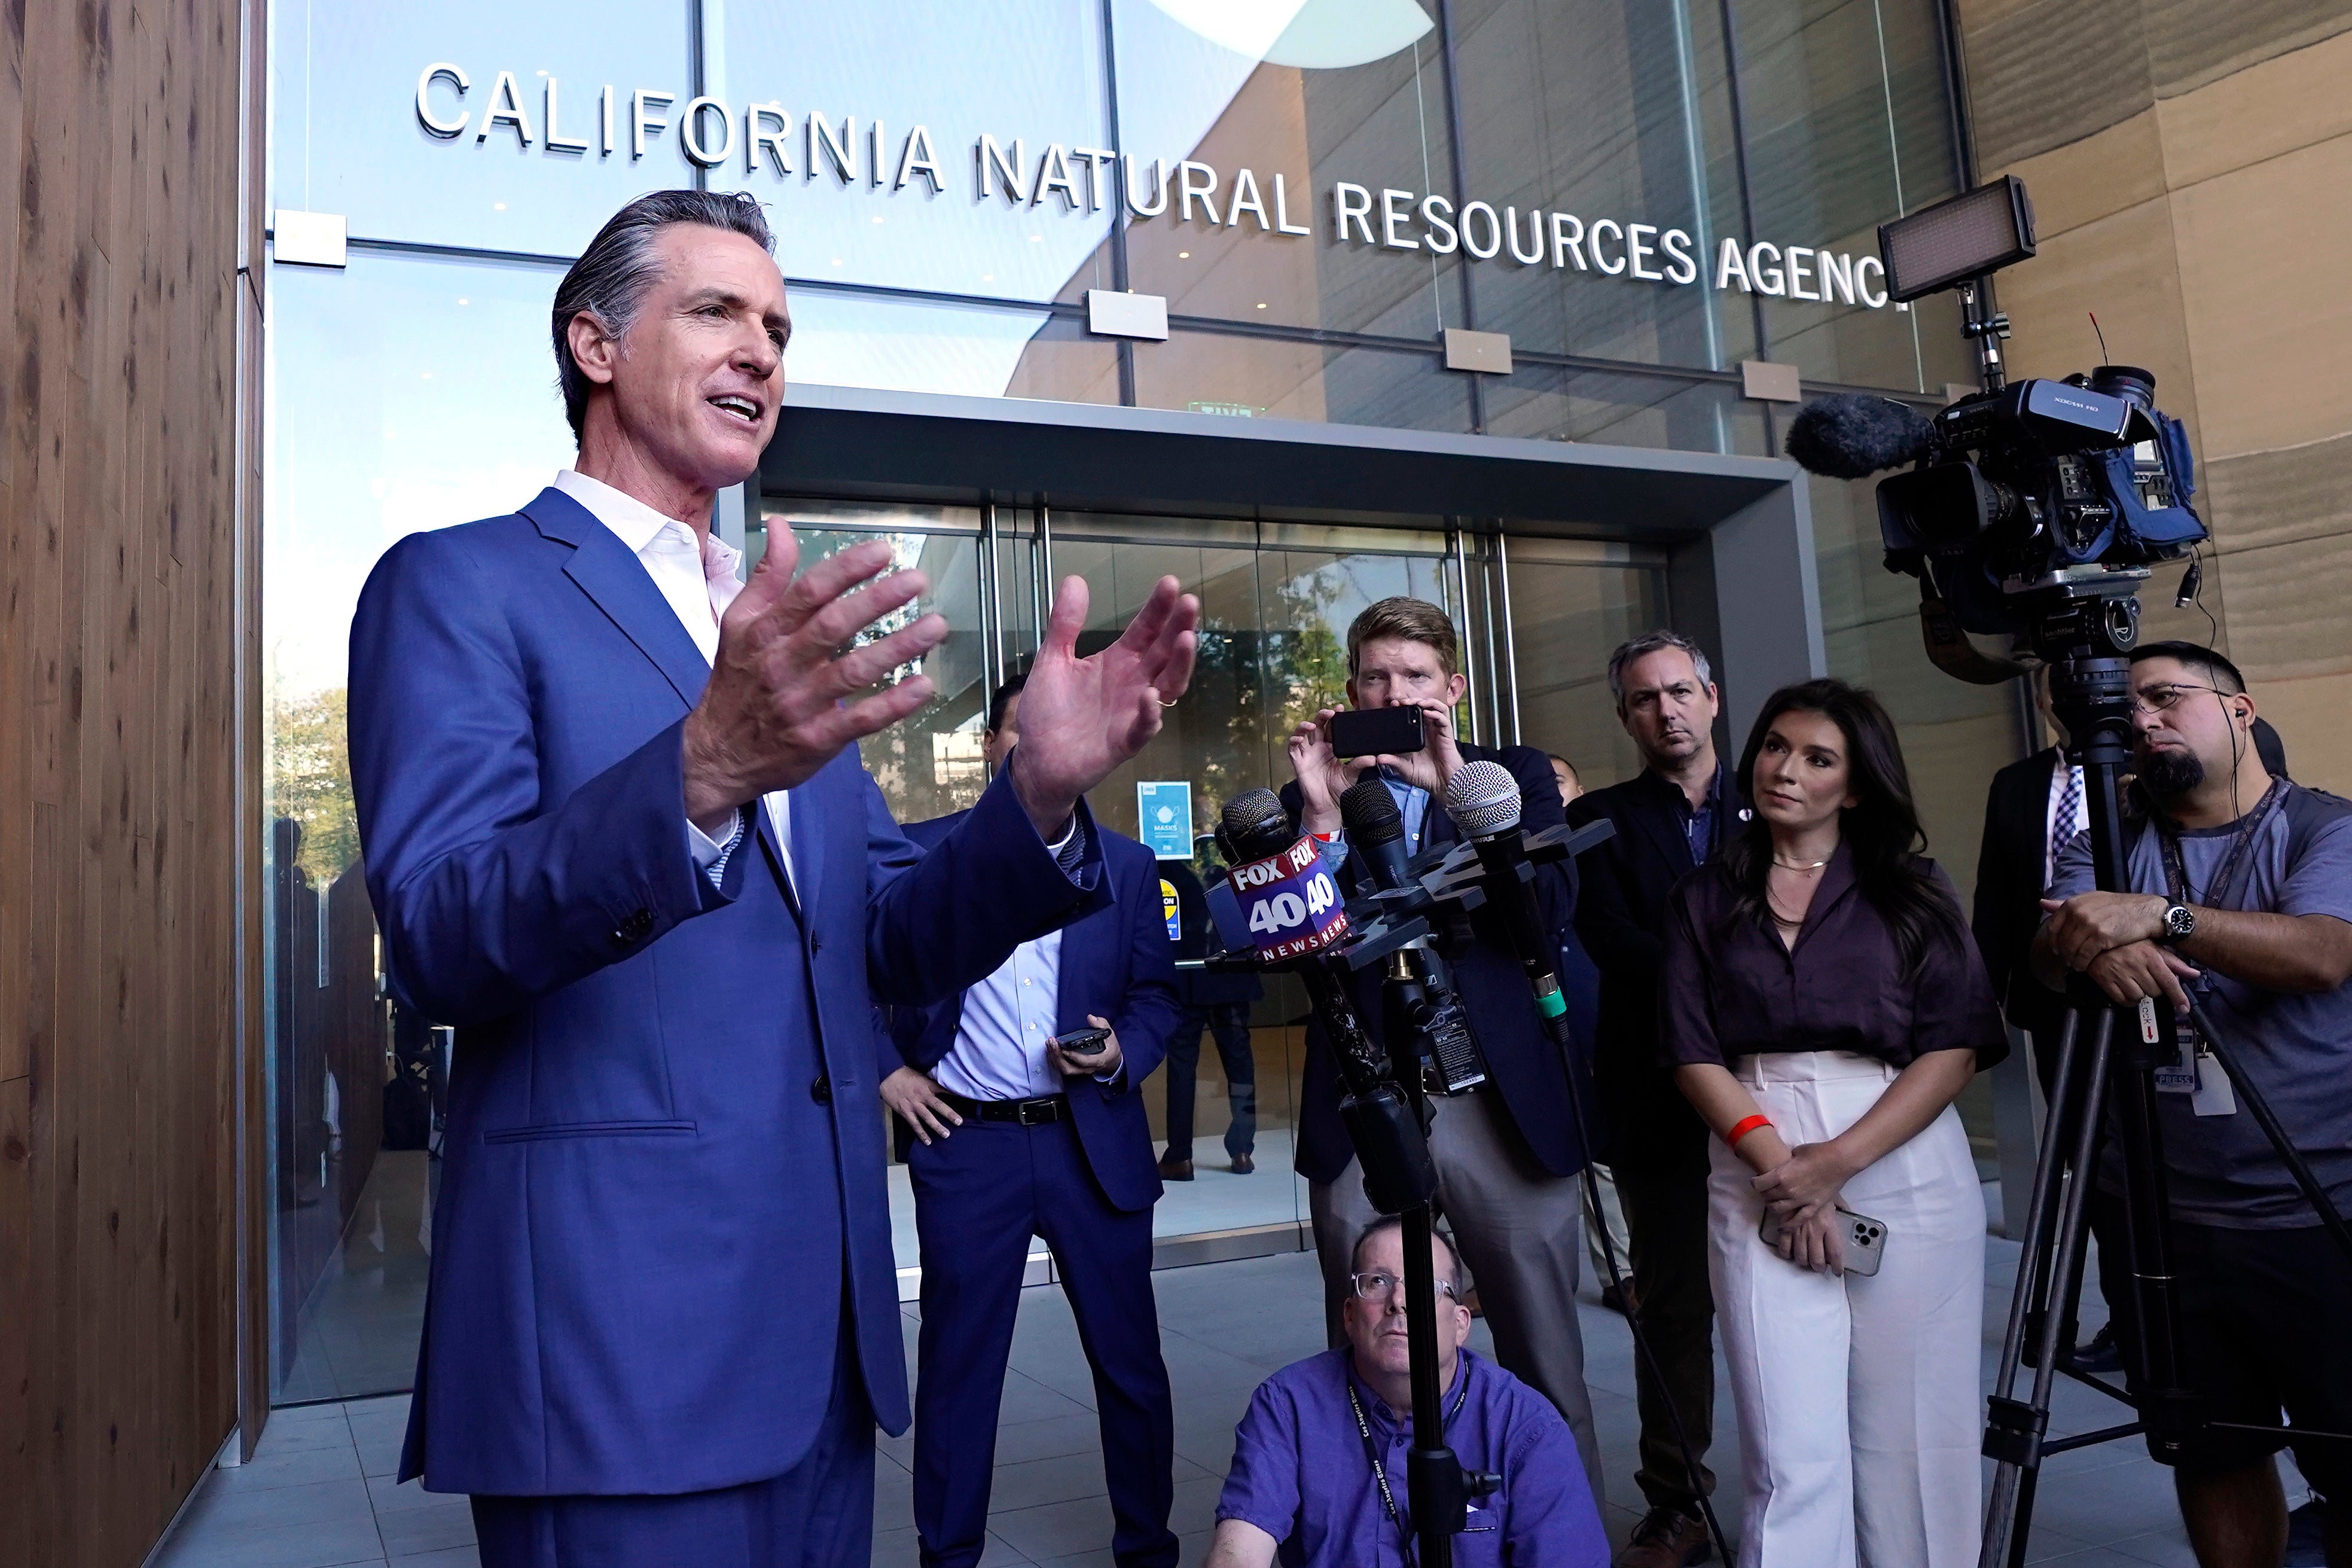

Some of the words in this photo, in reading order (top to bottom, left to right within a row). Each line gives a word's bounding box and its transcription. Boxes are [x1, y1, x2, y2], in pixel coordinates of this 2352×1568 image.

[416, 62, 945, 192] CALIFORNIA
[979, 133, 1311, 236] NATURAL
[1335, 181, 1697, 285] RESOURCES
[1716, 237, 1908, 312] AGENC
[1289, 838, 1316, 873] FOX
[1232, 858, 1286, 891] FOX
[1306, 872, 1335, 915] 40
[1249, 892, 1307, 934] 40
[1322, 914, 1347, 943] NEWS
[1262, 935, 1319, 962] NEWS
[2159, 1075, 2191, 1085] PRESS
[1348, 1386, 1357, 1404] Times
[1353, 1402, 1365, 1426] Angeles
[1373, 1459, 1384, 1479] Times
[1380, 1478, 1393, 1503] Angeles
